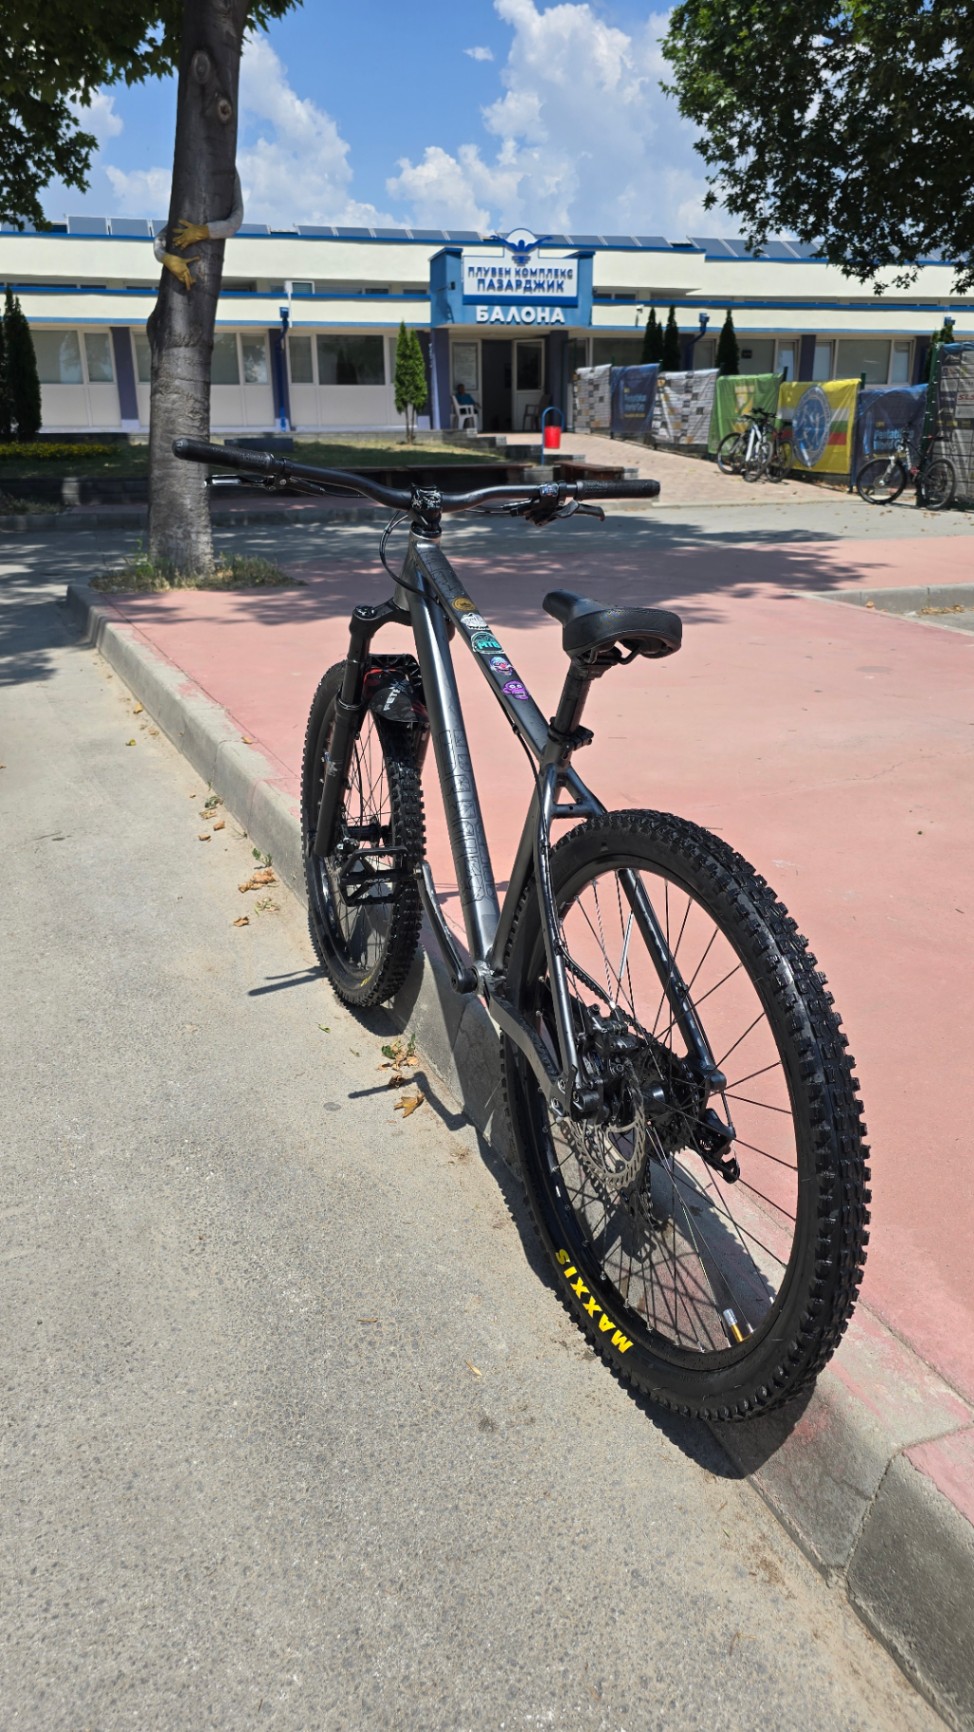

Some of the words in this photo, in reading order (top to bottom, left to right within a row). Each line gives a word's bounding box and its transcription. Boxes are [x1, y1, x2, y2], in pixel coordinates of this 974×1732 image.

[467, 266, 511, 279] ПЛУВЕН
[514, 267, 574, 280] КОМПЛЕКС
[477, 278, 565, 294] ПАЗАРДЖИК
[475, 306, 566, 324] БАЛОНА
[477, 640, 502, 650] MTB
[555, 1248, 634, 1354] MAXXIS
